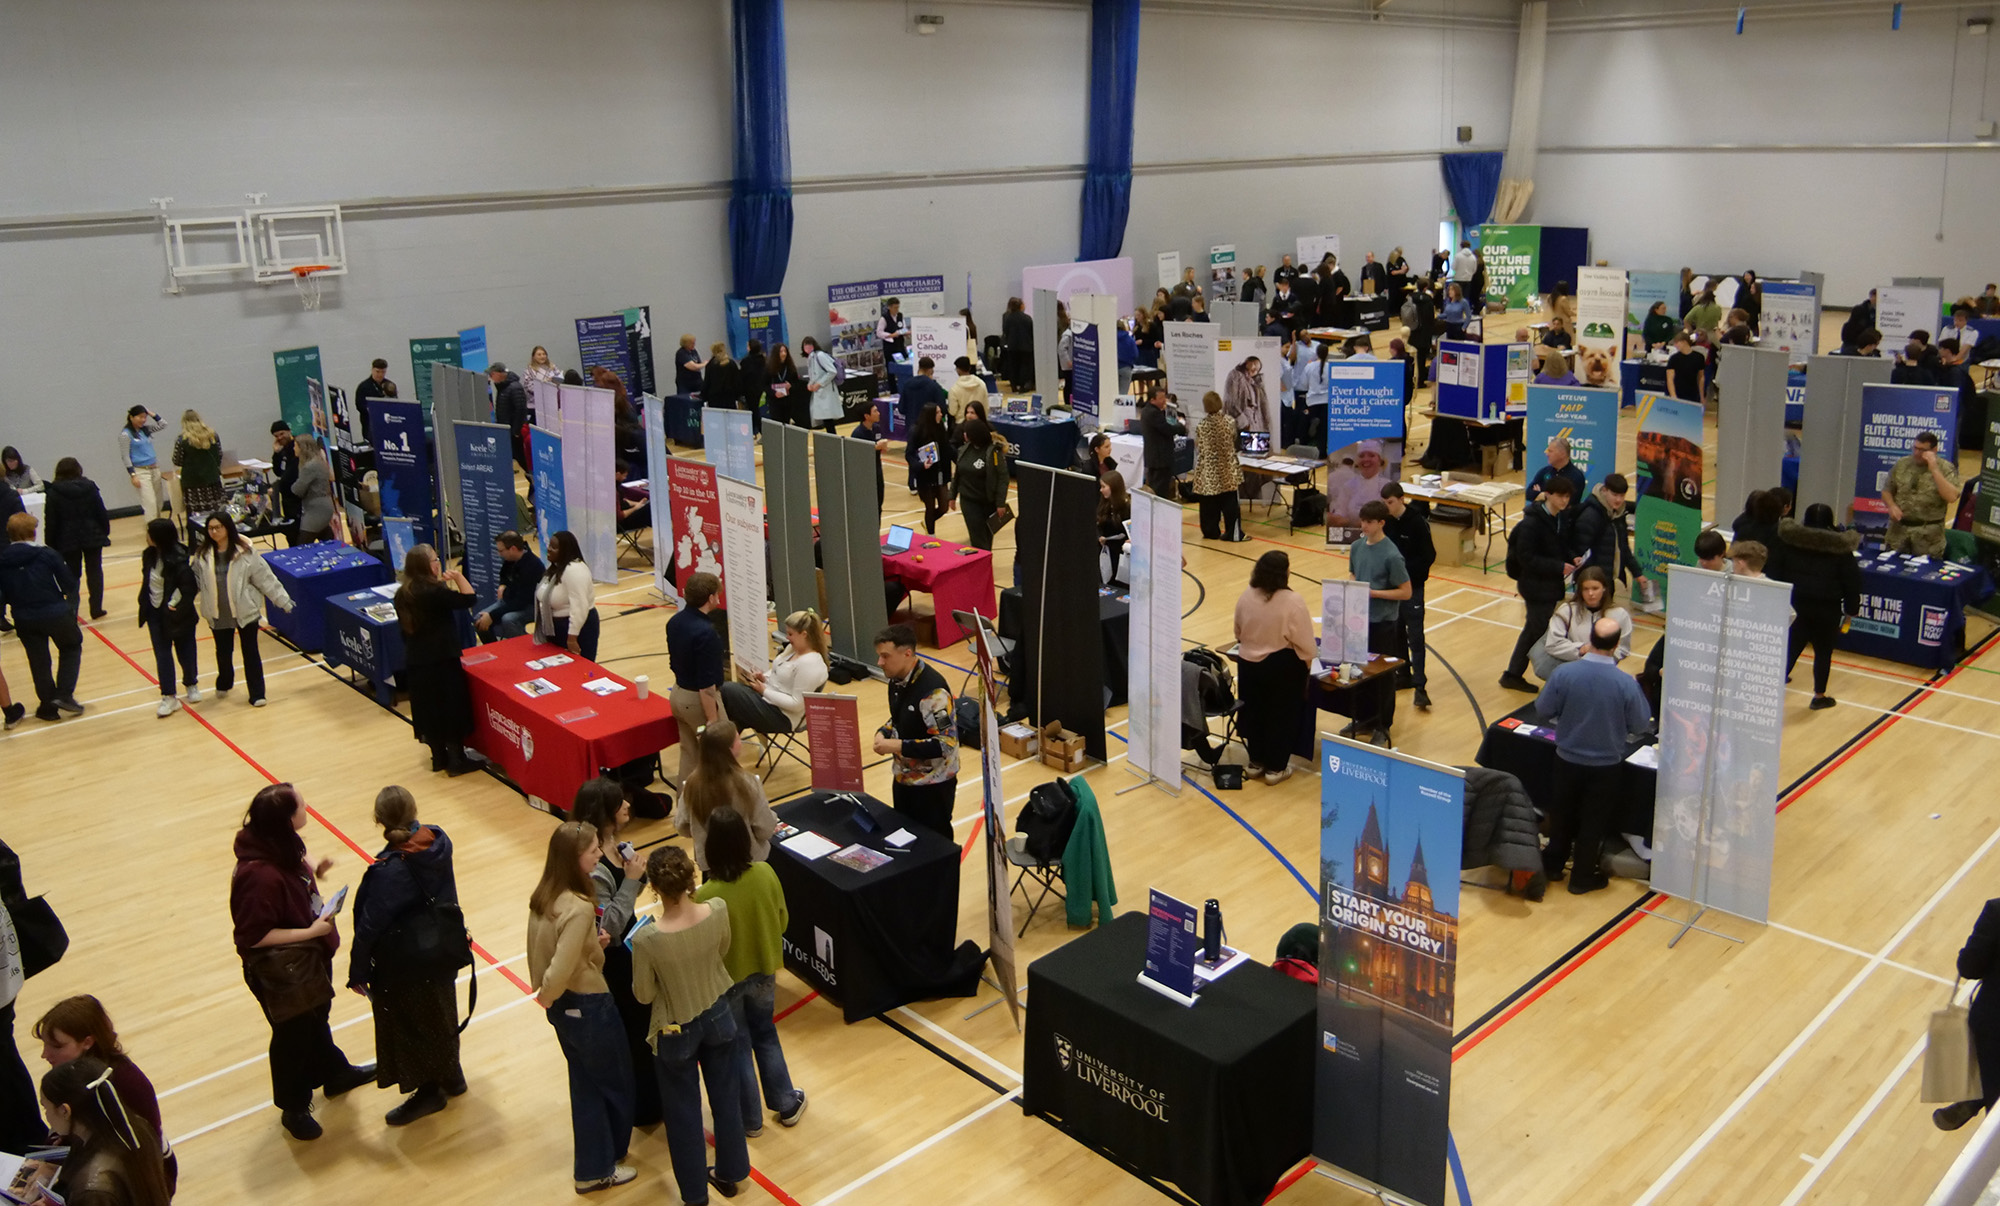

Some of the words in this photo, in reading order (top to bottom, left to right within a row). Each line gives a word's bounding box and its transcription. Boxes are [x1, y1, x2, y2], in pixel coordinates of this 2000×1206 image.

[1482, 245, 1508, 254] OUR
[1482, 256, 1531, 264] FUTURE
[900, 278, 941, 288] ORCHARDS
[1489, 276, 1516, 285] ITH
[832, 288, 844, 296] THE
[845, 284, 878, 293] ORCHARDS
[917, 342, 948, 350] Canada
[918, 351, 946, 360] Europe
[1332, 386, 1354, 396] Ever
[1355, 386, 1394, 398] thought
[1331, 396, 1358, 405] about
[1332, 404, 1342, 414] in
[1344, 404, 1370, 415] food?
[1560, 404, 1584, 412] PAID
[1872, 413, 1904, 425] WORLD
[1907, 416, 1942, 428] TRAVEL.
[1864, 424, 1887, 436] ELITE
[384, 440, 399, 452] No.
[400, 432, 410, 452] 1
[470, 442, 488, 453] Keele
[1864, 436, 1902, 449] ENDLESS
[476, 464, 493, 473] AREAS
[675, 464, 699, 475] Lancaster
[676, 472, 698, 483] University
[672, 483, 683, 495] Top
[695, 488, 706, 498] the
[706, 489, 716, 500] UK
[726, 512, 736, 524] Our
[737, 518, 759, 534] subjects
[1871, 596, 1882, 608] IN
[1884, 598, 1902, 612] THE
[1873, 608, 1900, 624] NAVY
[340, 630, 362, 654] Keele
[486, 702, 520, 735] Lancaster
[491, 718, 521, 749] University
[1341, 760, 1378, 774] UNIVERSITY
[1341, 766, 1388, 787] LIVERPOOL
[1332, 889, 1380, 917] START
[1383, 907, 1427, 935] YOUR
[1332, 904, 1385, 935] ORIGIN
[1388, 924, 1442, 954] STORY
[795, 948, 808, 963] OF
[810, 956, 837, 986] LEEDS
[1076, 1050, 1144, 1091] UNIVERSITY
[1149, 1088, 1166, 1100] OF
[1077, 1062, 1169, 1123] LIVERPOOL
